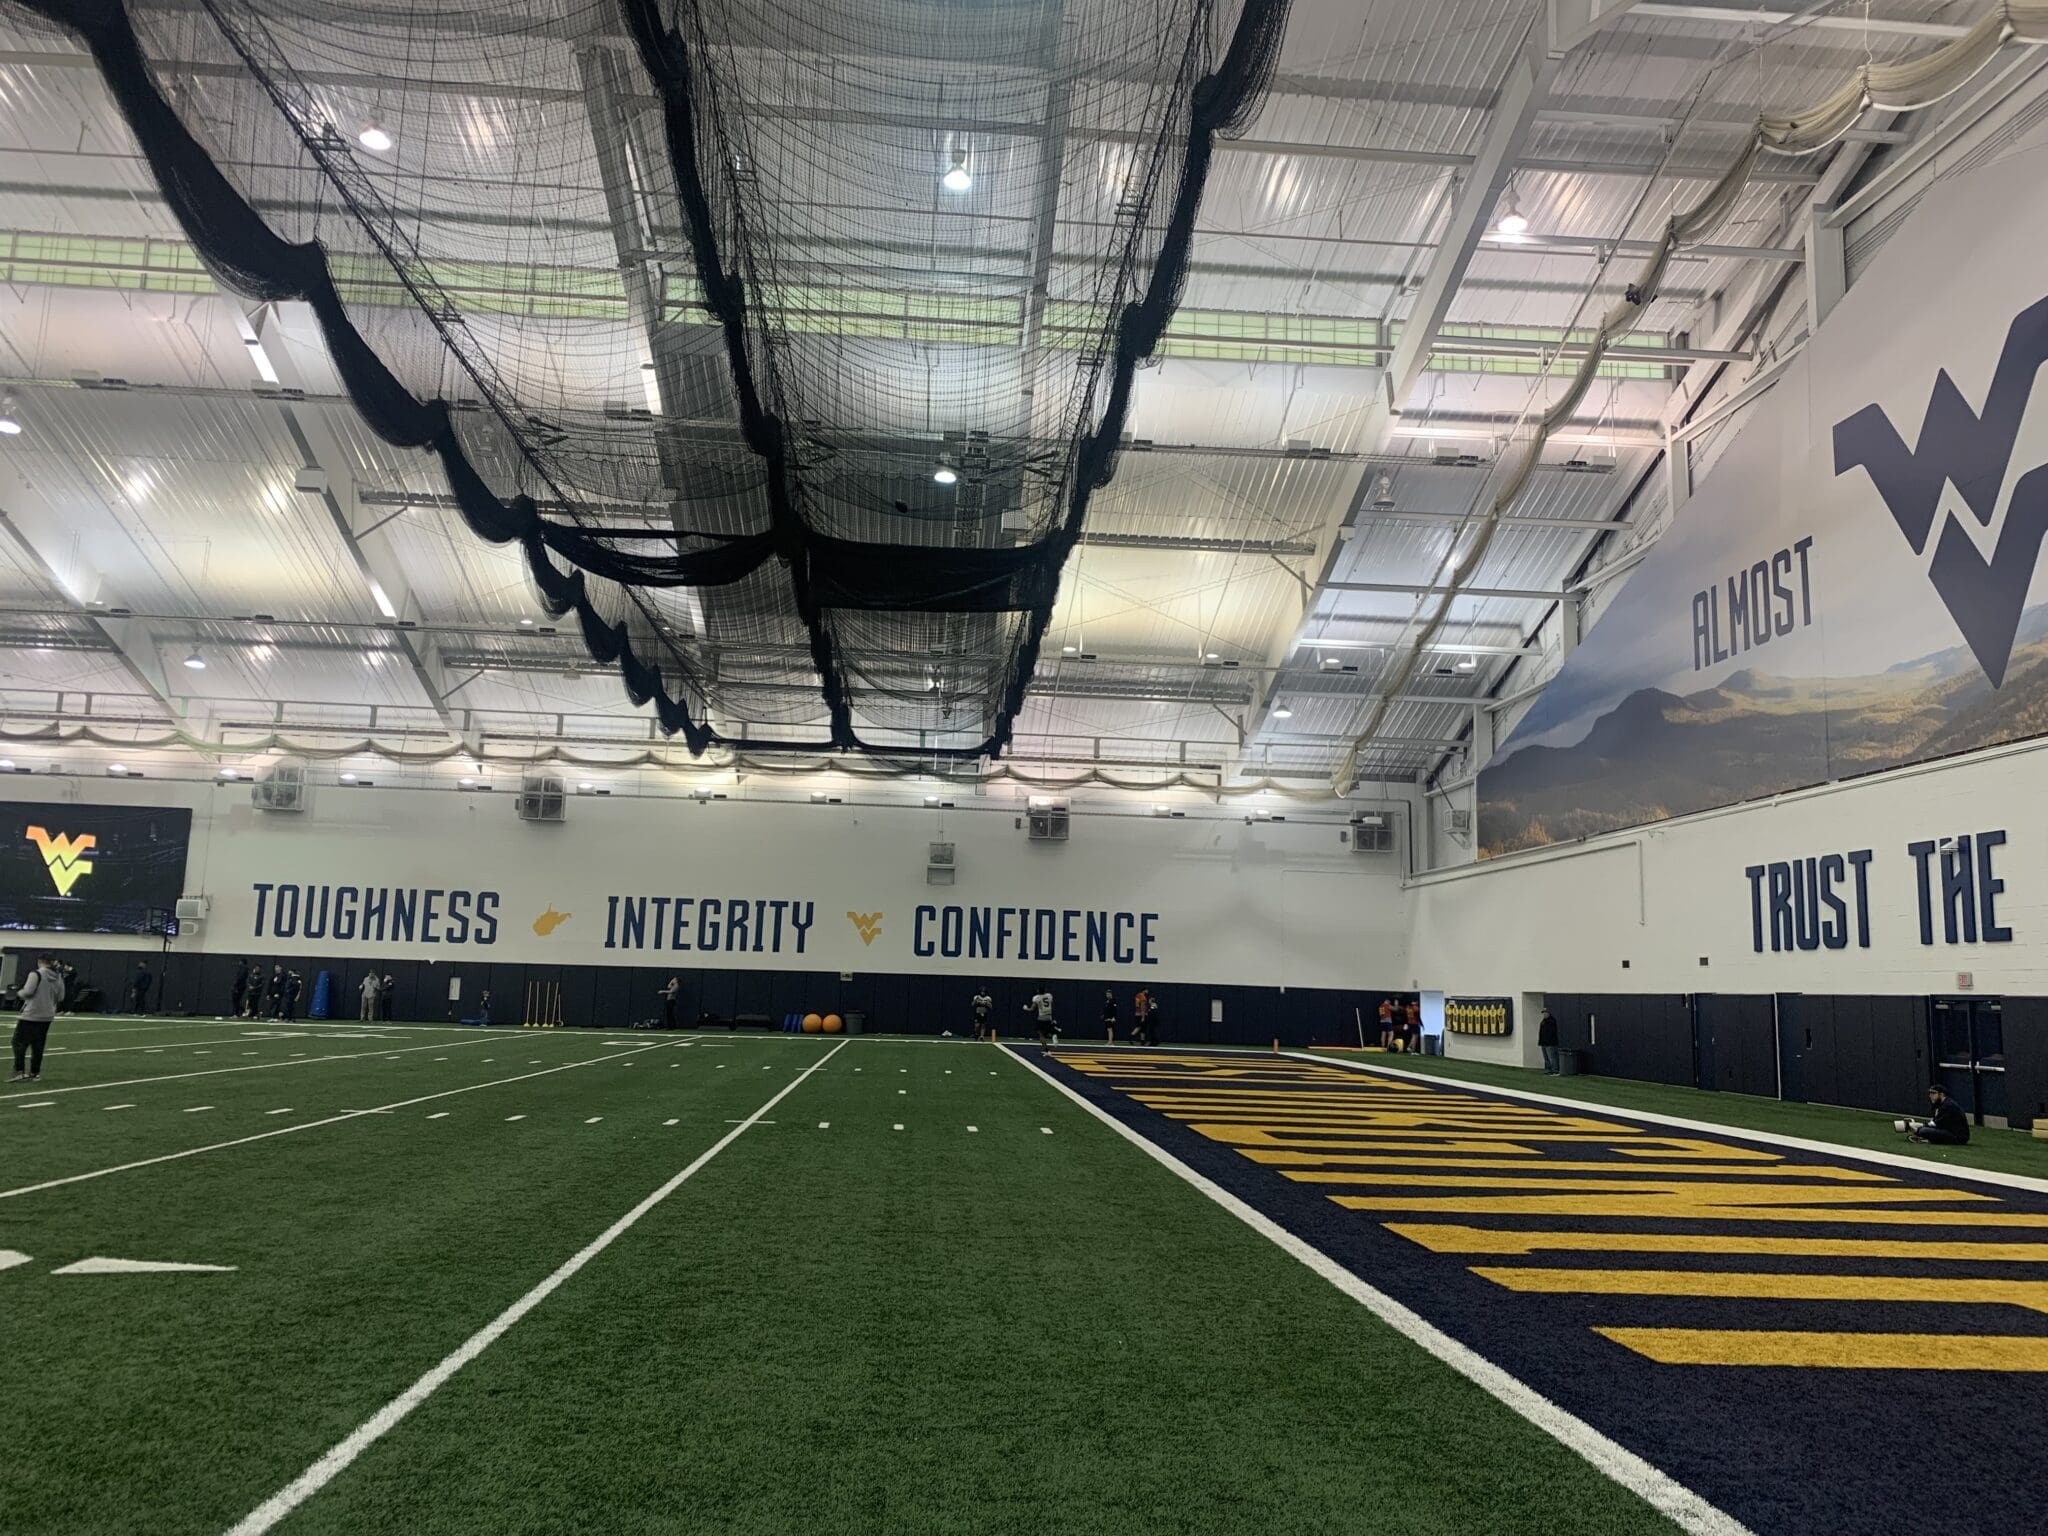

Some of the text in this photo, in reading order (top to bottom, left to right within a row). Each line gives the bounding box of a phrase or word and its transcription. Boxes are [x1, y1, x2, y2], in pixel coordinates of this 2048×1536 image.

[1693, 535, 1814, 672] ALMOST
[253, 884, 500, 945] TOUGHNESS
[1745, 830, 2013, 953] TRUST THE
[604, 896, 814, 954] INTEGRITY
[914, 905, 1159, 965] CONFIDENCE
